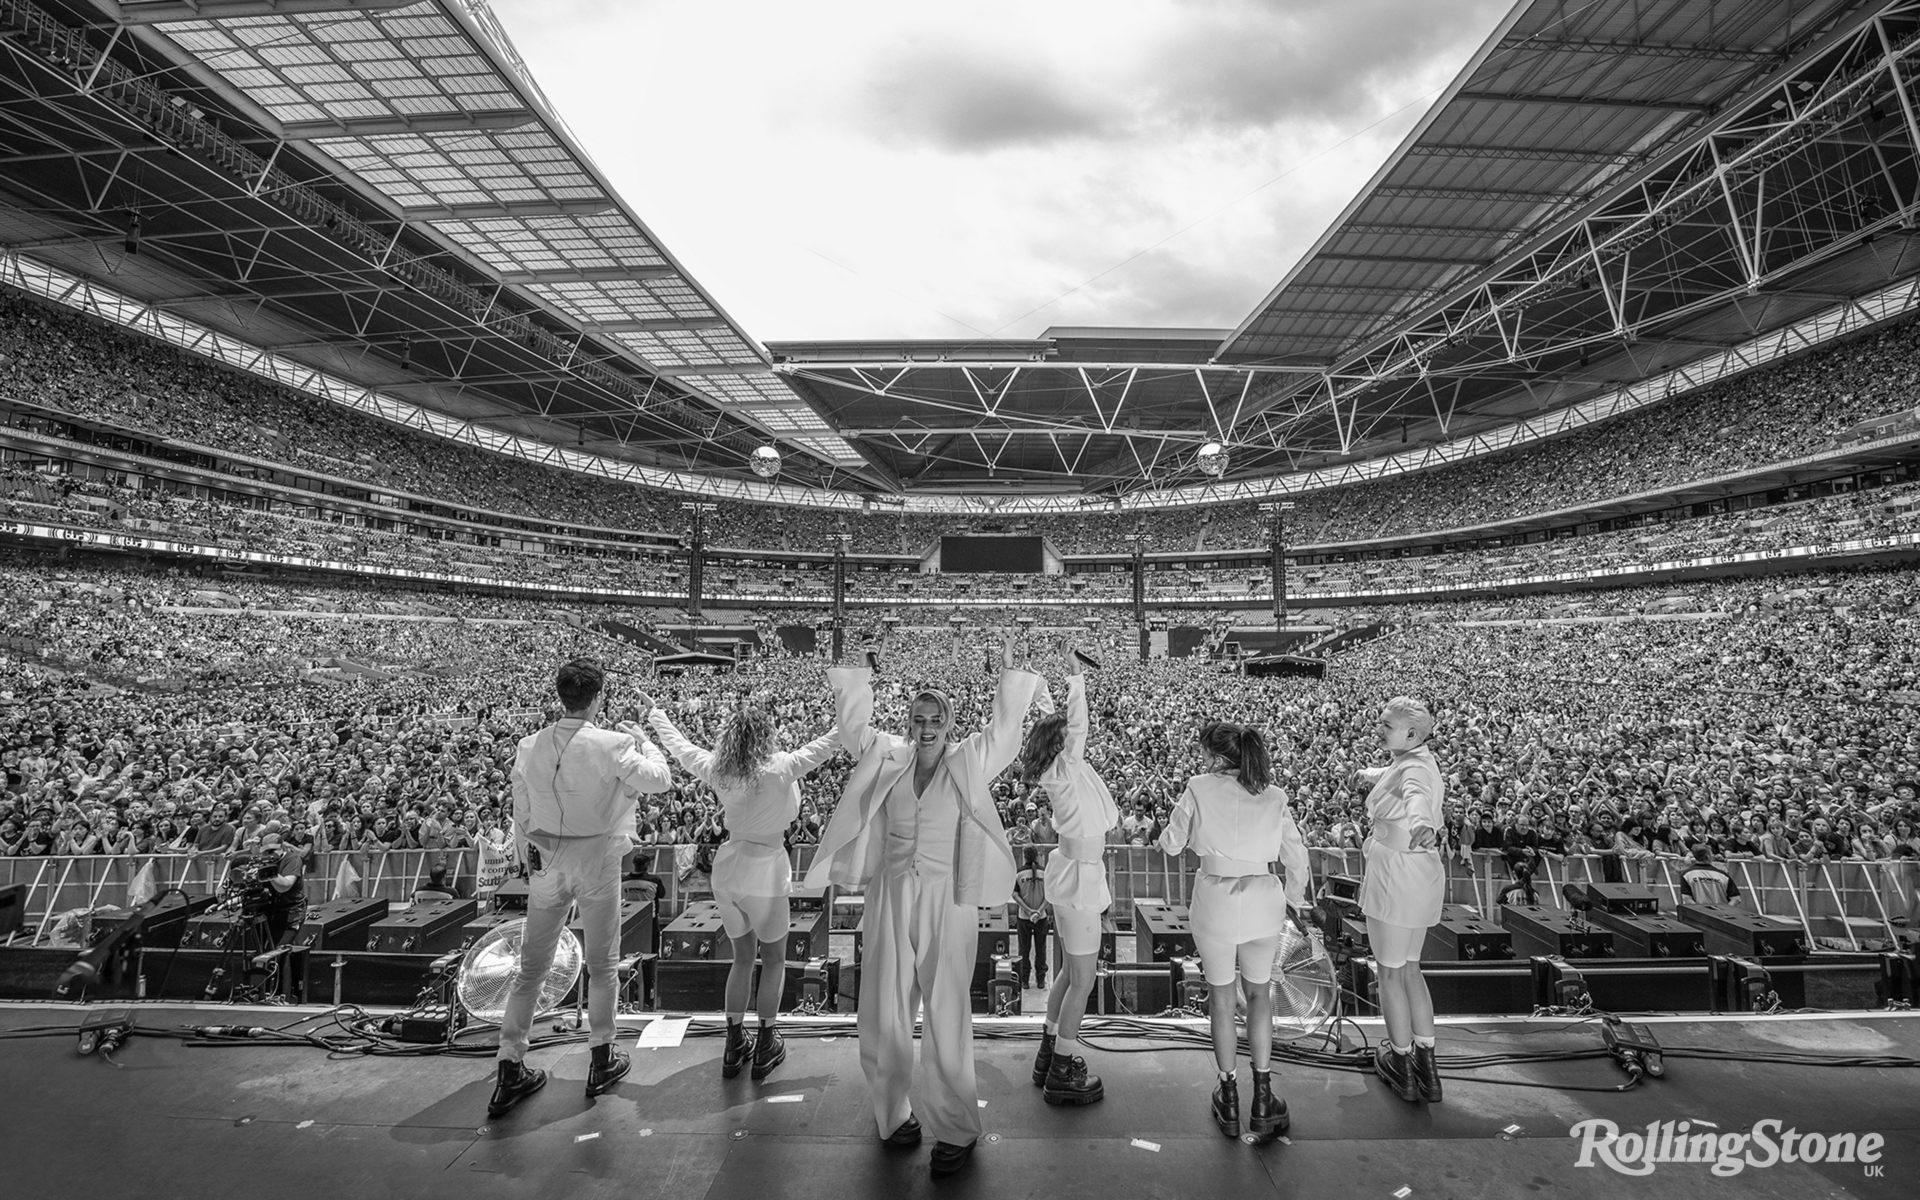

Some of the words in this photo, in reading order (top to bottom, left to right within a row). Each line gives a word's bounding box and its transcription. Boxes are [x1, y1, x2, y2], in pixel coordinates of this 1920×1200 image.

[65, 530, 83, 541] blur
[126, 537, 142, 547] blur
[1874, 537, 1891, 546] blur
[180, 544, 194, 553] blur
[1817, 545, 1837, 553] blur
[228, 549, 241, 558] blur
[1768, 550, 1781, 558] blur
[1723, 555, 1735, 563] blur
[484, 857, 504, 865] until
